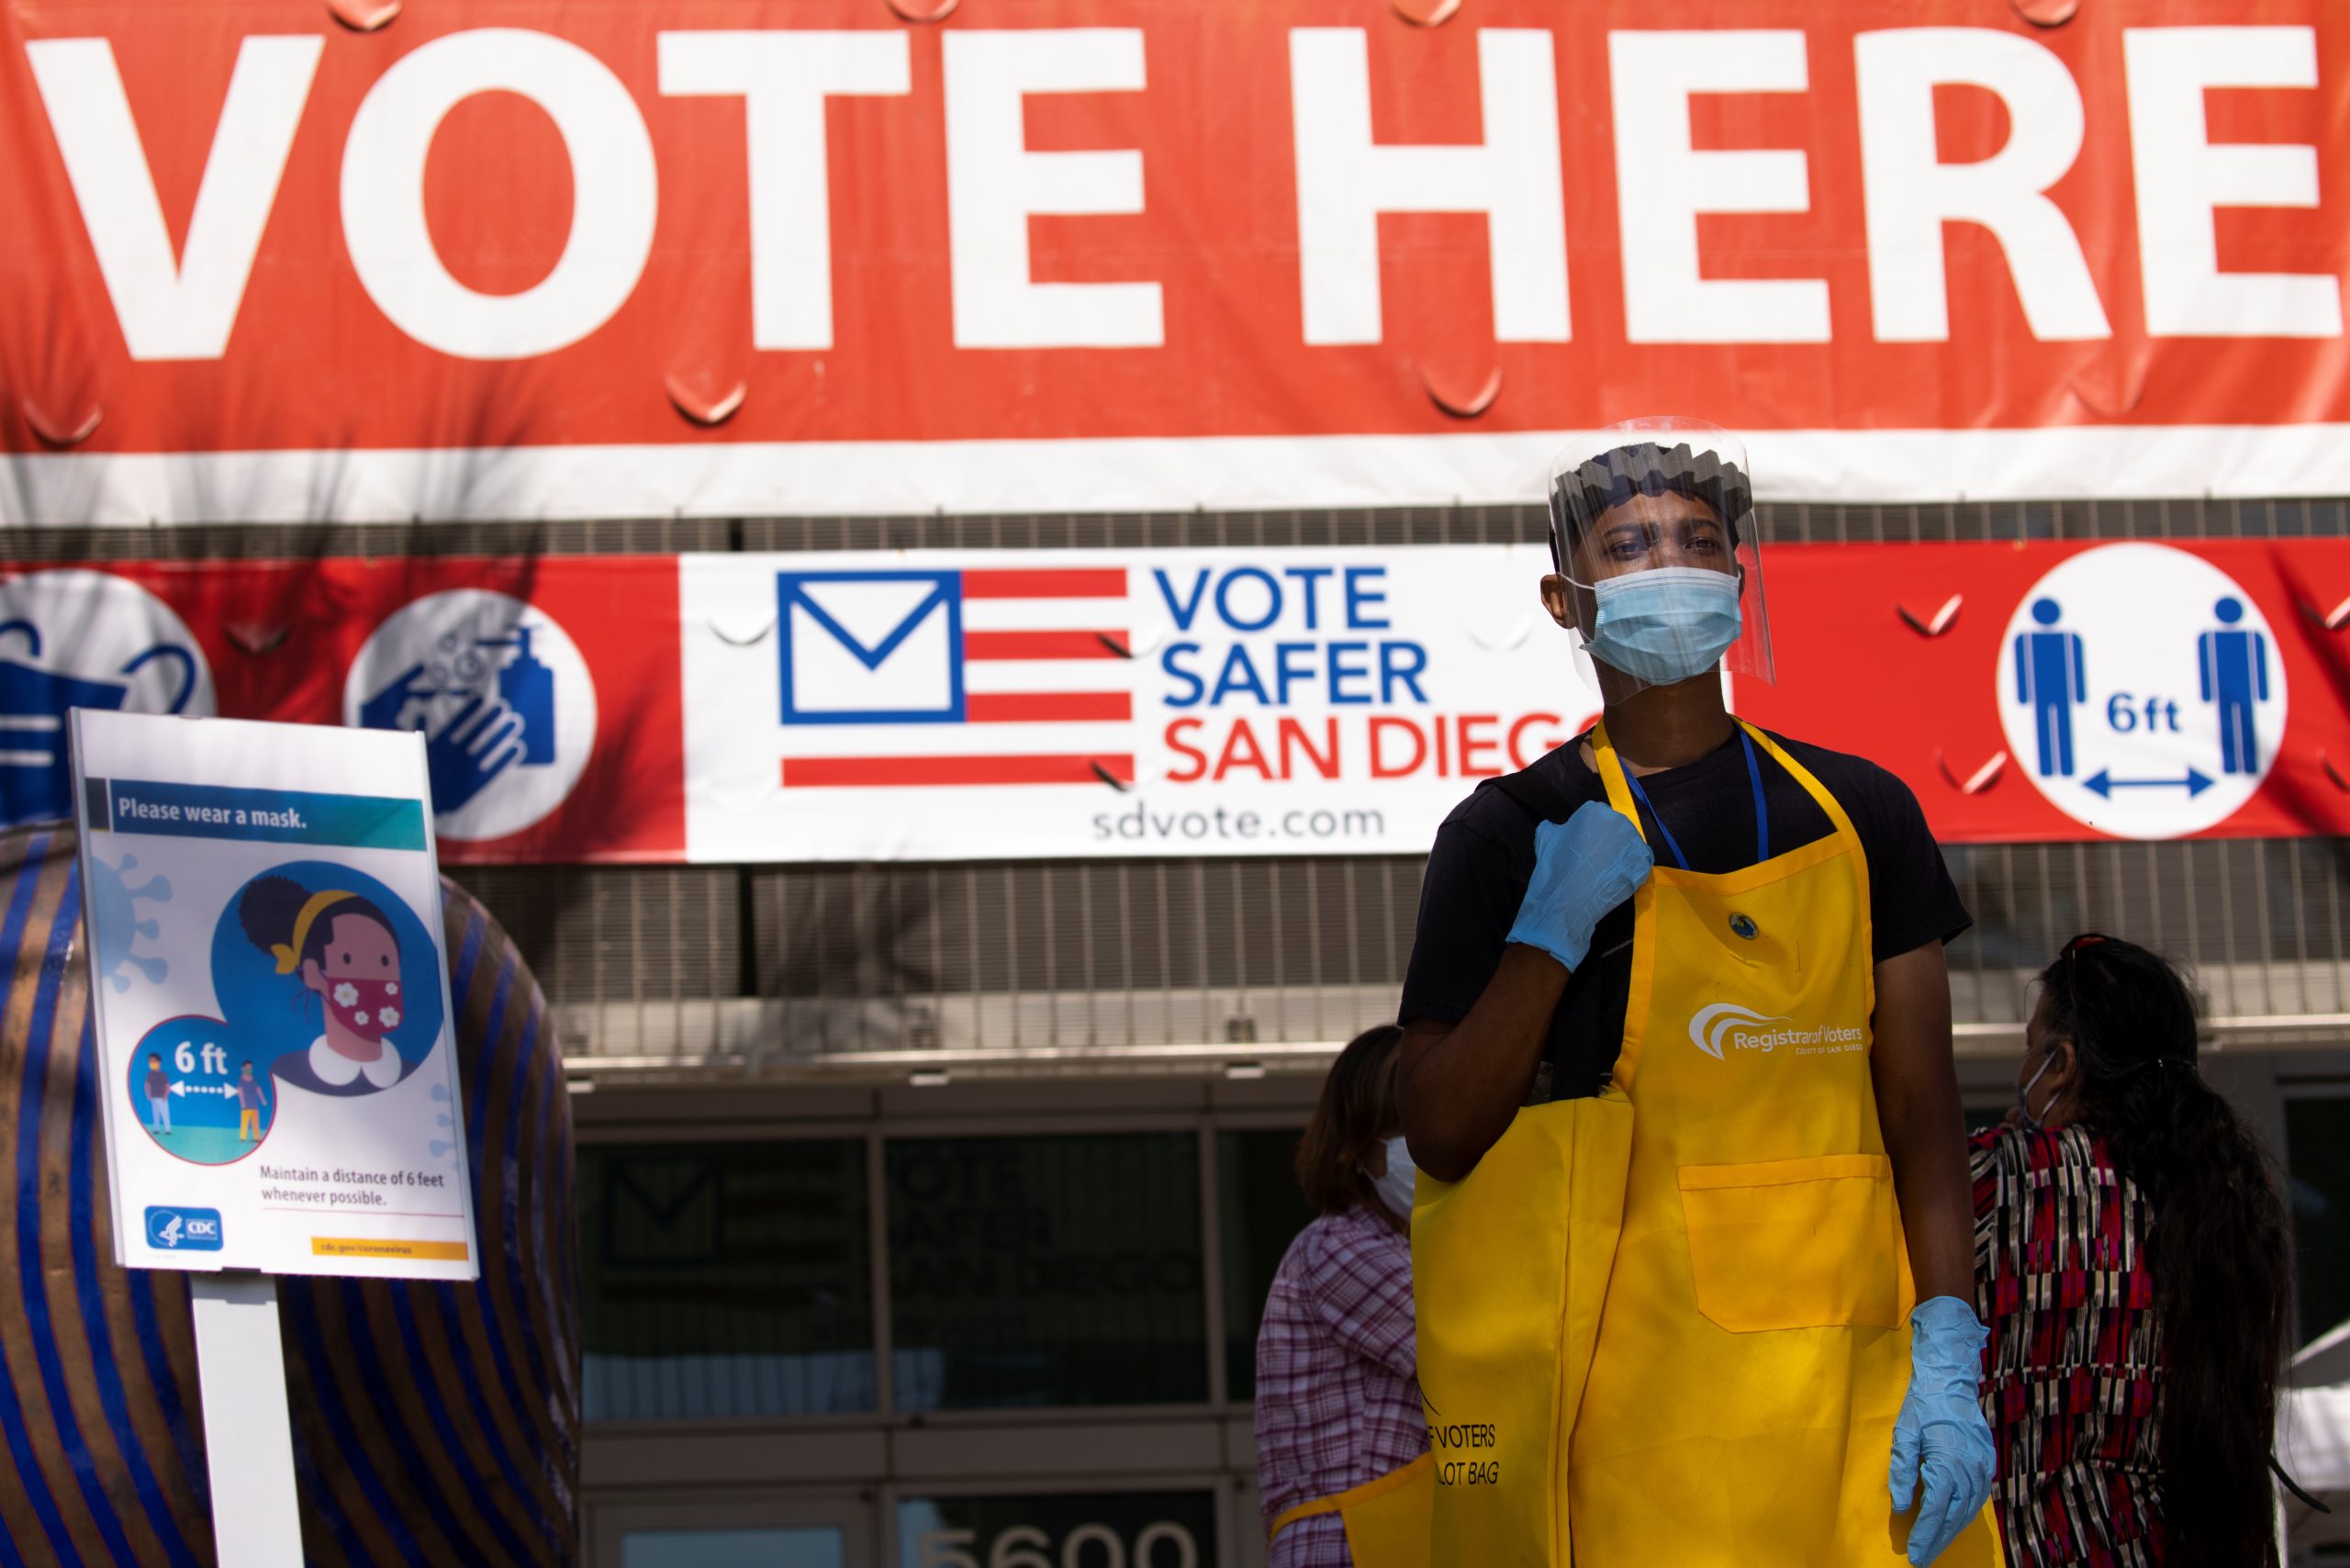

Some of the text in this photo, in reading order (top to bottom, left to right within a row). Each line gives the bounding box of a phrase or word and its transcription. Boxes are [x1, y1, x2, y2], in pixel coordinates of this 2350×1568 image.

[24, 26, 2344, 360] VOTE HERE
[1152, 566, 1392, 632] VOTE
[1160, 640, 1429, 707] SAFER
[1163, 711, 1605, 783] SAN DIEG
[118, 797, 308, 828] Please wear a mask.
[1092, 801, 1385, 839] sdvote.com
[1823, 1025, 1863, 1043] Voters
[174, 1041, 228, 1075] 6 ft
[1827, 1045, 1841, 1054] SAN
[1843, 1044, 1863, 1052] DIEGO
[261, 1166, 444, 1188] Maintain a distance of 6 feet
[262, 1187, 386, 1206] whenever possible.
[188, 1221, 217, 1235] CDC
[320, 1242, 412, 1255] cdc.gov/coronavirus
[1435, 1424, 1495, 1449] VOTERS
[1468, 1462, 1499, 1485] BAG
